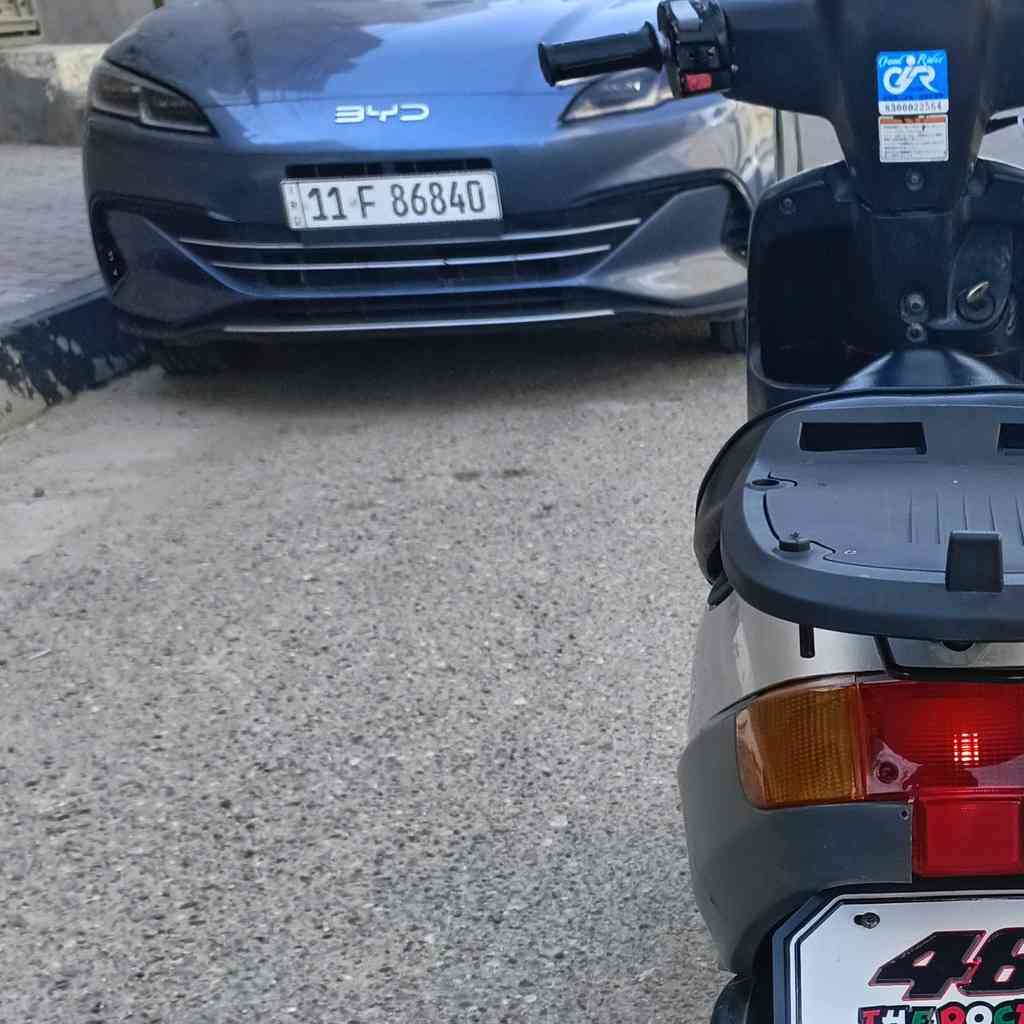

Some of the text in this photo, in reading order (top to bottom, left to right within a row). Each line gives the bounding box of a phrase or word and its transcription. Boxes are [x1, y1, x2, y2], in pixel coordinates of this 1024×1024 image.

[336, 103, 430, 123] BYD
[307, 187, 347, 221] 11
[357, 185, 376, 218] F
[389, 180, 487, 217] 86840
